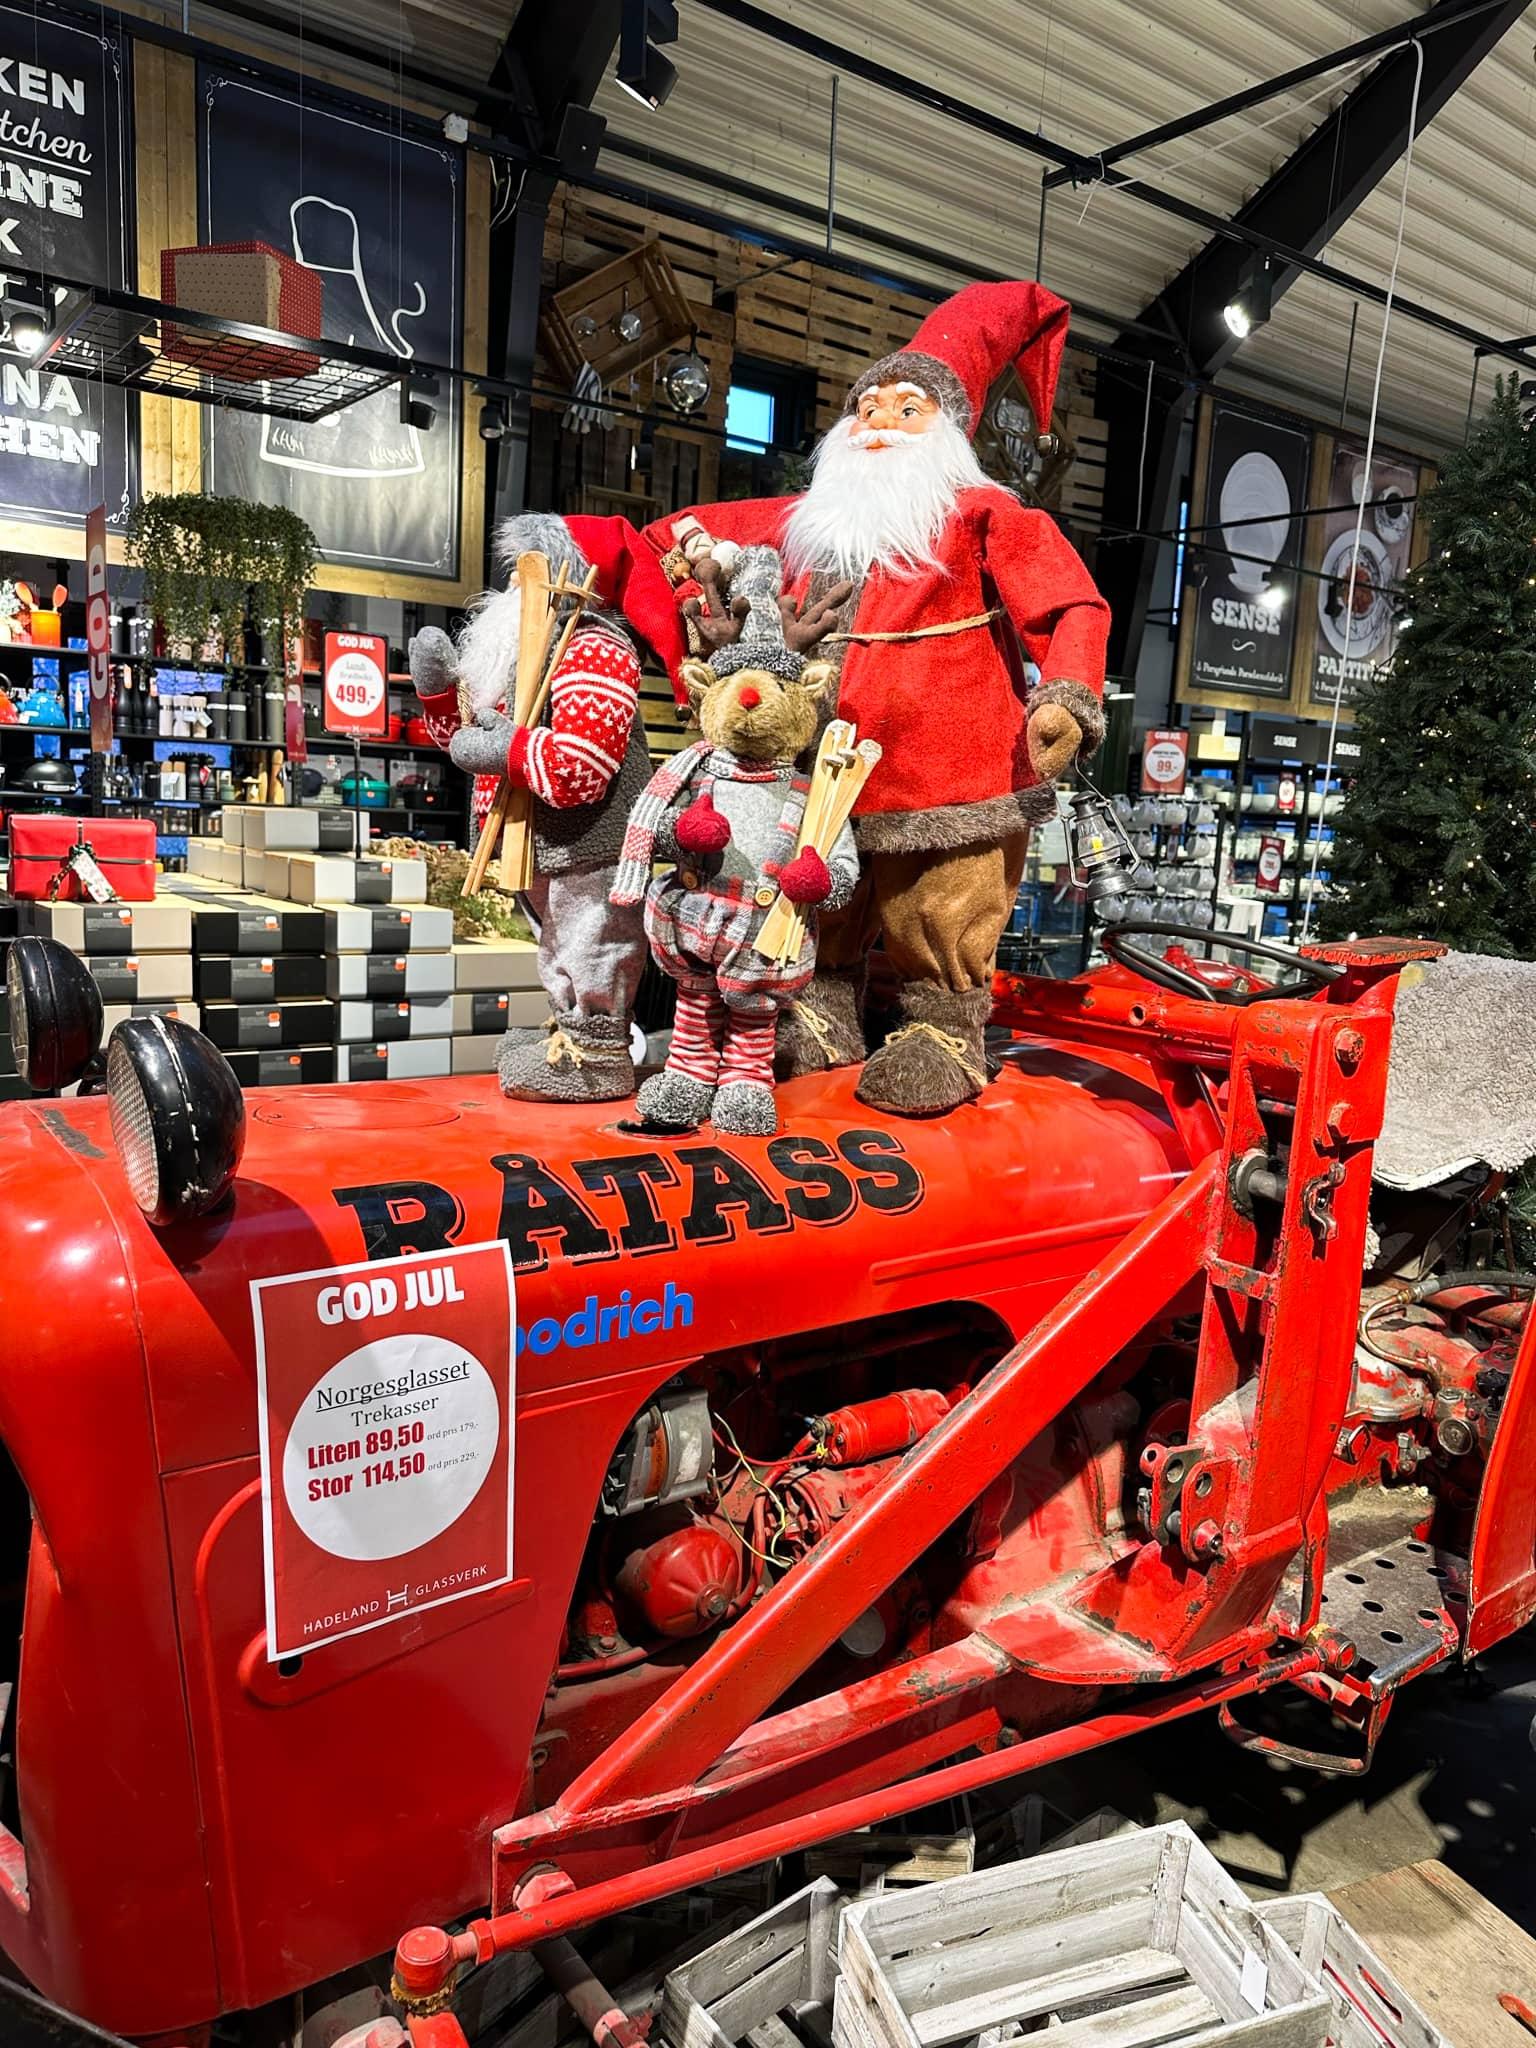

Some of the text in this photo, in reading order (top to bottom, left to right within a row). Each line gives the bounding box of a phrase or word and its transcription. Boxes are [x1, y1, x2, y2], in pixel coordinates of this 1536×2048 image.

[1211, 597, 1281, 635] SENSE
[337, 635, 375, 650] GOD JUL
[336, 684, 376, 706] 499,-
[1334, 742, 1361, 757] SENSE
[332, 1129, 924, 1275] RÅTASS
[316, 1266, 465, 1326] GOD JUL
[316, 1360, 470, 1410] Norgesglasset
[351, 1396, 439, 1428] Trekasser
[307, 1440, 361, 1470] Liten
[366, 1421, 425, 1456] 89,50
[427, 1431, 441, 1441] ord
[442, 1426, 458, 1439] pris
[308, 1473, 353, 1501] Stor
[362, 1452, 426, 1488] 114,50
[428, 1461, 442, 1472] ord
[443, 1456, 459, 1470] pris
[303, 1601, 380, 1635] HADELAND
[415, 1564, 488, 1597] GLASSVERK
